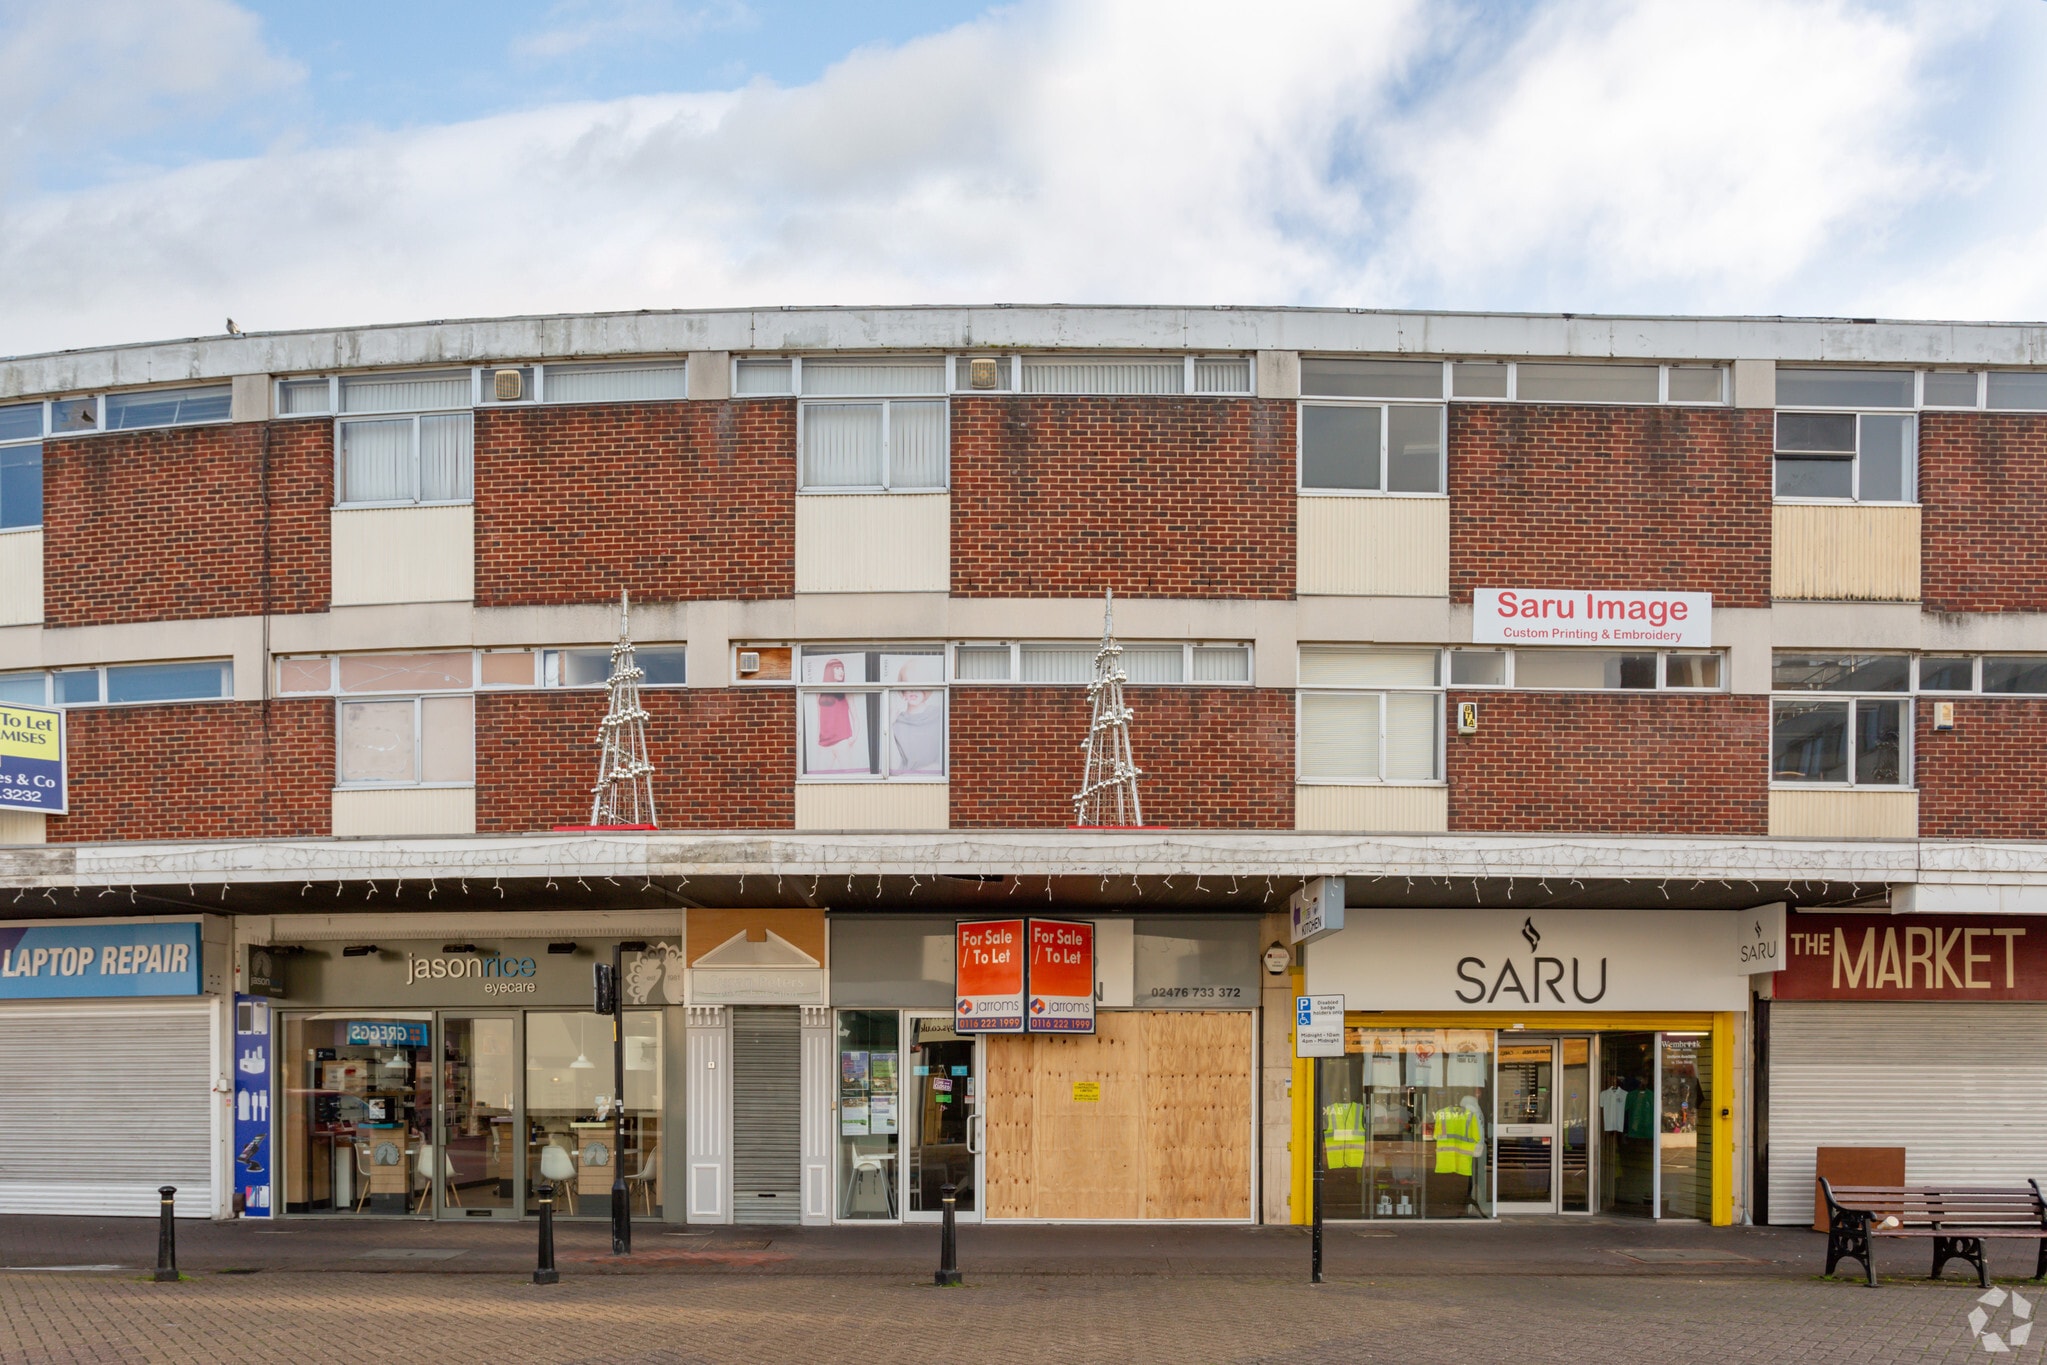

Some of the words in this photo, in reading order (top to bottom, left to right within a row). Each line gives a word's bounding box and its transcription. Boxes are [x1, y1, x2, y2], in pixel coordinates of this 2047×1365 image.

[1497, 591, 1574, 619] Saru
[1587, 593, 1688, 627] Image
[1503, 627, 1548, 638] Custom
[1552, 628, 1598, 642] Printing
[1601, 629, 1610, 639] &
[1613, 629, 1682, 643] Embroidery
[0, 712, 21, 727] To
[27, 716, 52, 731] Let
[16, 773, 29, 785] &
[33, 775, 56, 788] Co
[0, 788, 42, 802] 3232
[1301, 916, 1322, 937] KITCHEN
[962, 931, 982, 946] For
[985, 928, 1013, 945] Sale
[1034, 927, 1054, 944] For
[1057, 929, 1083, 945] Sale
[2, 946, 95, 977] LAPTOP
[100, 943, 189, 975] REPAIR
[973, 949, 989, 965] To
[992, 948, 1011, 963] Let
[1045, 947, 1060, 963] To
[1063, 948, 1081, 965] Let
[1740, 940, 1777, 963] SARU
[1790, 933, 1830, 956] THE
[1832, 927, 2026, 989] MARKET
[406, 951, 537, 985] jasonrice
[1455, 956, 1607, 1004] SARU
[484, 982, 536, 996] eyecare
[1151, 987, 1189, 998] 02476
[1192, 987, 1215, 998] 733
[1218, 987, 1241, 998] 372
[975, 1000, 1019, 1014] jarroms
[1047, 1000, 1090, 1014] jarroms
[1300, 999, 1309, 1010] P
[959, 1019, 979, 1028] 0116
[981, 1019, 997, 1028] 222
[1000, 1018, 1020, 1028] 1999
[1032, 1018, 1051, 1028] 0116
[1053, 1019, 1068, 1028] 222
[1071, 1019, 1091, 1029] 1999
